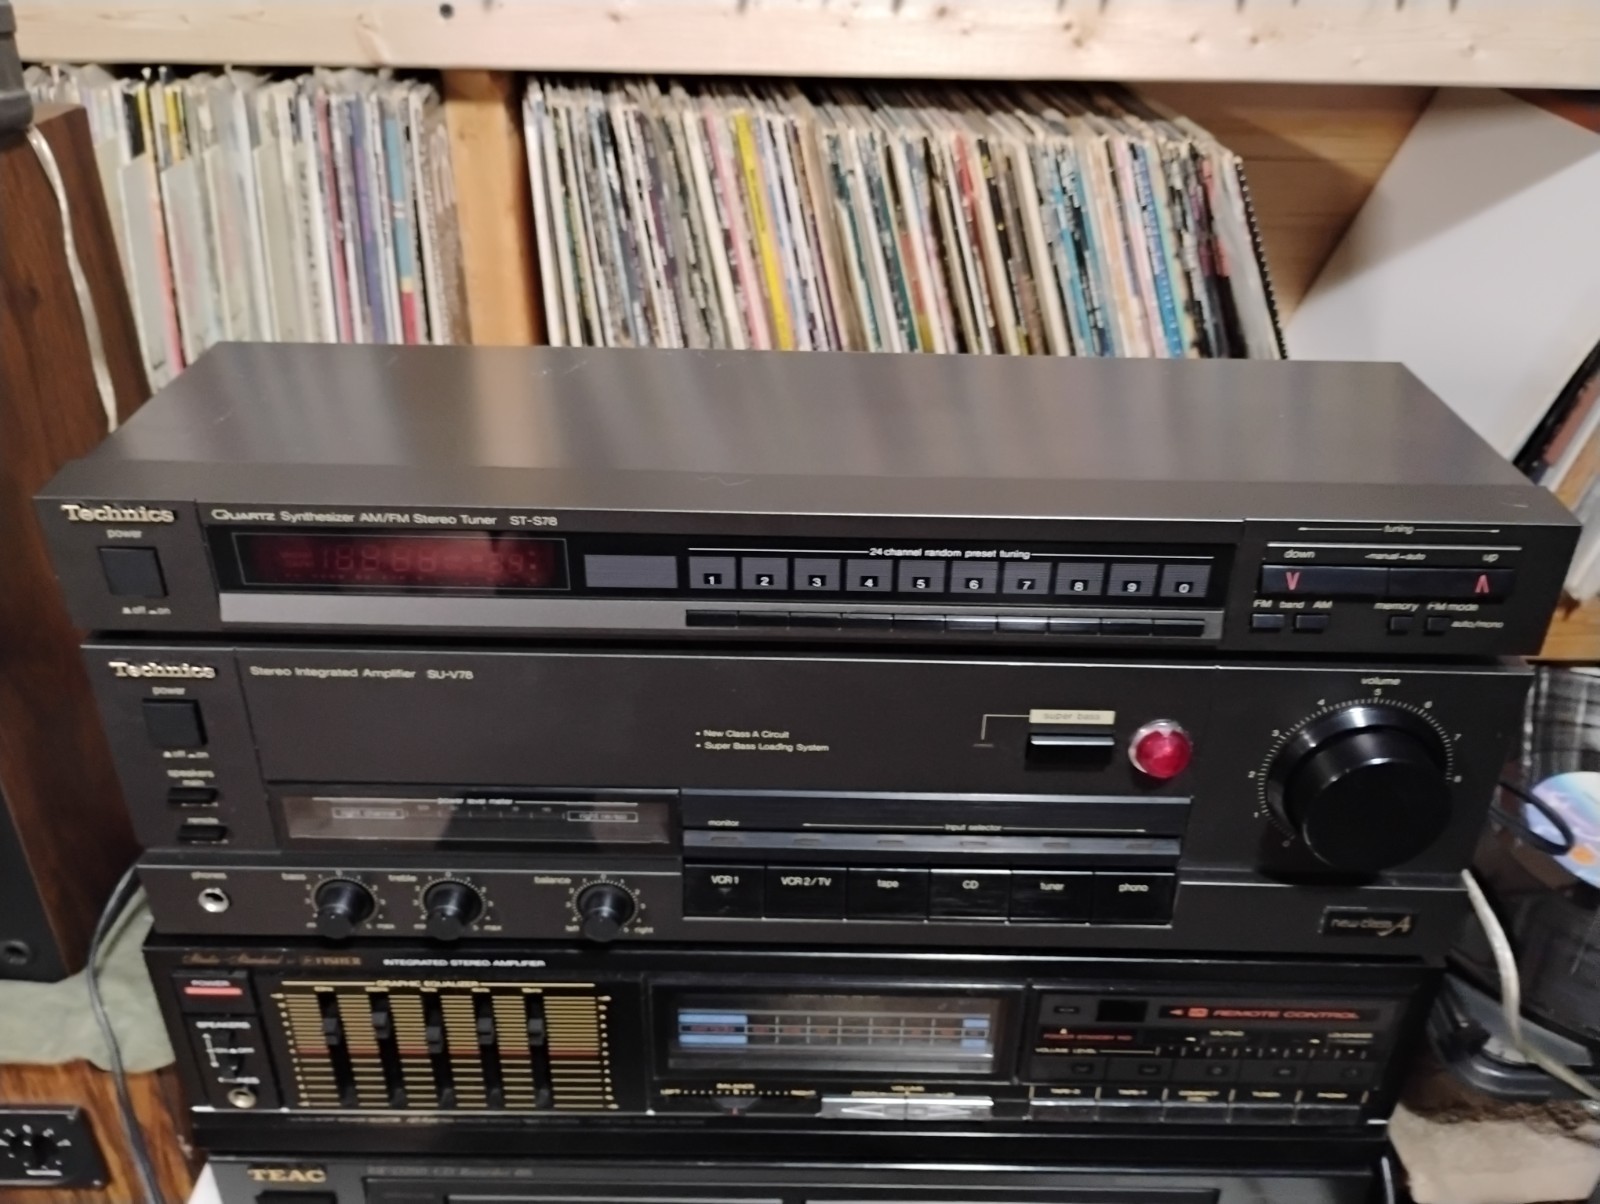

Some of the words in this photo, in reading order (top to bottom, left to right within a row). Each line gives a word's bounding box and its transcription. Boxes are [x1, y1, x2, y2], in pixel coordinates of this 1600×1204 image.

[60, 504, 175, 522] Technics
[280, 511, 355, 524] Synthesizer
[359, 513, 410, 524] AM/FM
[413, 514, 457, 525] Stereo
[461, 514, 497, 525] Tuner
[509, 515, 558, 527] ST-S78
[106, 529, 142, 539] power
[1383, 524, 1414, 535] tuning
[869, 547, 883, 556] 24
[883, 547, 922, 557] channel
[924, 549, 962, 557] random
[964, 550, 997, 559] preset
[999, 550, 1031, 560] tuning
[1284, 550, 1315, 559] down
[1482, 553, 1499, 562] up
[707, 575, 715, 585] 1
[760, 576, 770, 586] 2
[812, 577, 822, 587] 3
[863, 578, 874, 588] 4
[916, 579, 926, 589] 5
[968, 579, 979, 590] 6
[1022, 580, 1032, 590] 7
[1073, 581, 1084, 591] 8
[1127, 582, 1137, 592] 9
[1253, 600, 1273, 609] FM
[1279, 600, 1305, 609] band
[1312, 600, 1333, 609] AM
[1373, 602, 1419, 612] memory
[1426, 602, 1446, 611] FM
[1446, 602, 1479, 611] mode
[1450, 620, 1504, 629] auto/mono
[108, 661, 217, 678] Technics
[250, 666, 292, 676] Stereo
[295, 667, 358, 678] Integrated
[362, 668, 416, 679] Amplifier
[427, 669, 474, 680] SU-V78
[1360, 677, 1401, 686] volume
[703, 729, 724, 738] New
[726, 730, 751, 738] Class
[761, 730, 790, 739] Circuit
[704, 741, 731, 751] Super
[733, 742, 756, 750] Bass
[758, 742, 794, 752] Loading
[796, 743, 829, 753] System
[708, 819, 739, 827] monitor
[944, 823, 966, 832] input
[968, 824, 1002, 832] selector
[711, 875, 734, 884] VCR
[781, 877, 803, 886] VCR
[876, 879, 900, 888] tape
[962, 880, 979, 889] CD
[1040, 882, 1065, 891] tuner
[1118, 883, 1149, 892] phono
[383, 958, 448, 967] INTEGRATED
[450, 958, 491, 967] STEREO
[492, 959, 546, 967] AMPLIFIER
[1212, 1010, 1280, 1019] REMOTE
[1283, 1011, 1360, 1020] CONTROL
[247, 1168, 327, 1183] TEAC
